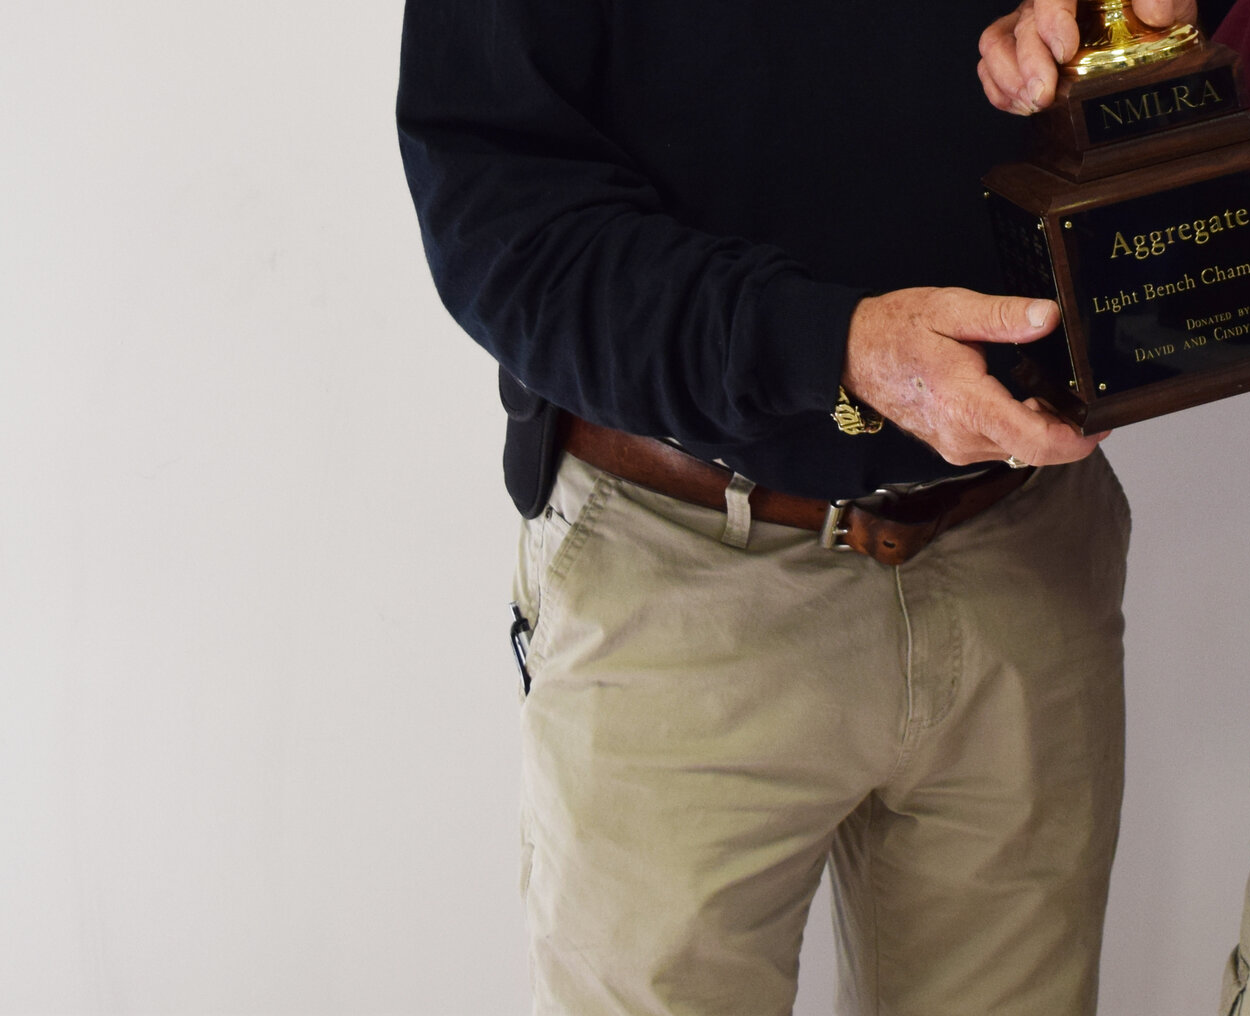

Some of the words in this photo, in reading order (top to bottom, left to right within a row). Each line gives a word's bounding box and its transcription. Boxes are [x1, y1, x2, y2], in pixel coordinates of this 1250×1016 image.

[1100, 79, 1222, 129] NMLRA
[1110, 208, 1250, 260] Aggregate
[1093, 291, 1139, 314] Light
[1143, 273, 1196, 301] Bench
